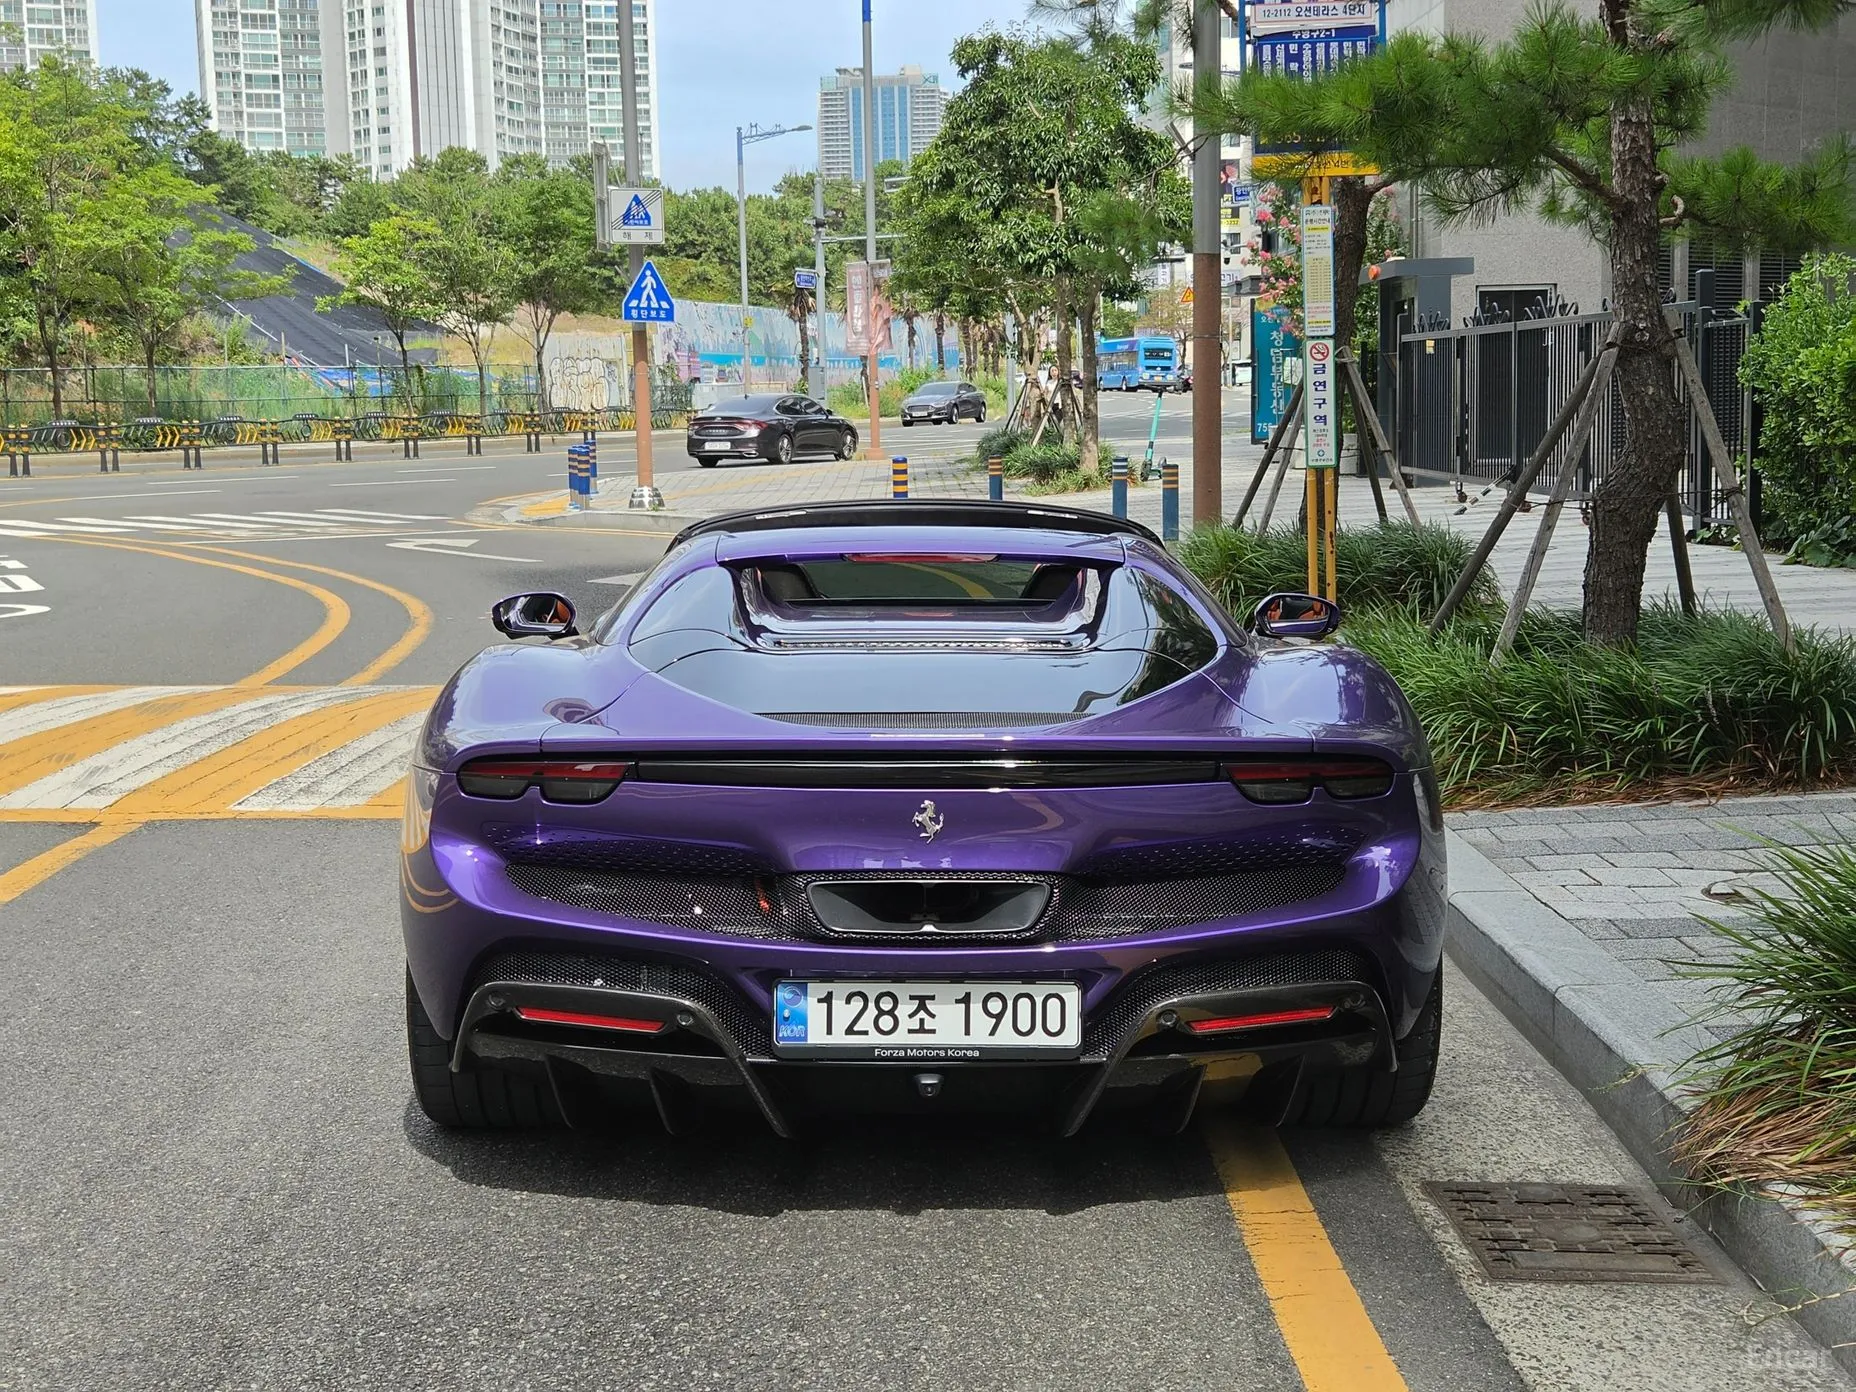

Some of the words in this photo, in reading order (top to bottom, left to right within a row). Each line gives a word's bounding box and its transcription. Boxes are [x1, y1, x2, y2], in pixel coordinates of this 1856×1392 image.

[1295, 6, 1339, 17] 오션테라스
[630, 308, 667, 319] 횡단보도
[1312, 363, 1329, 427] 금연구역
[816, 990, 937, 1037] 128조
[955, 991, 1067, 1037] 1900
[778, 1023, 805, 1038] KOR
[874, 1048, 905, 1058] Forza
[907, 1048, 946, 1058] Motors
[947, 1048, 980, 1058] Korea
